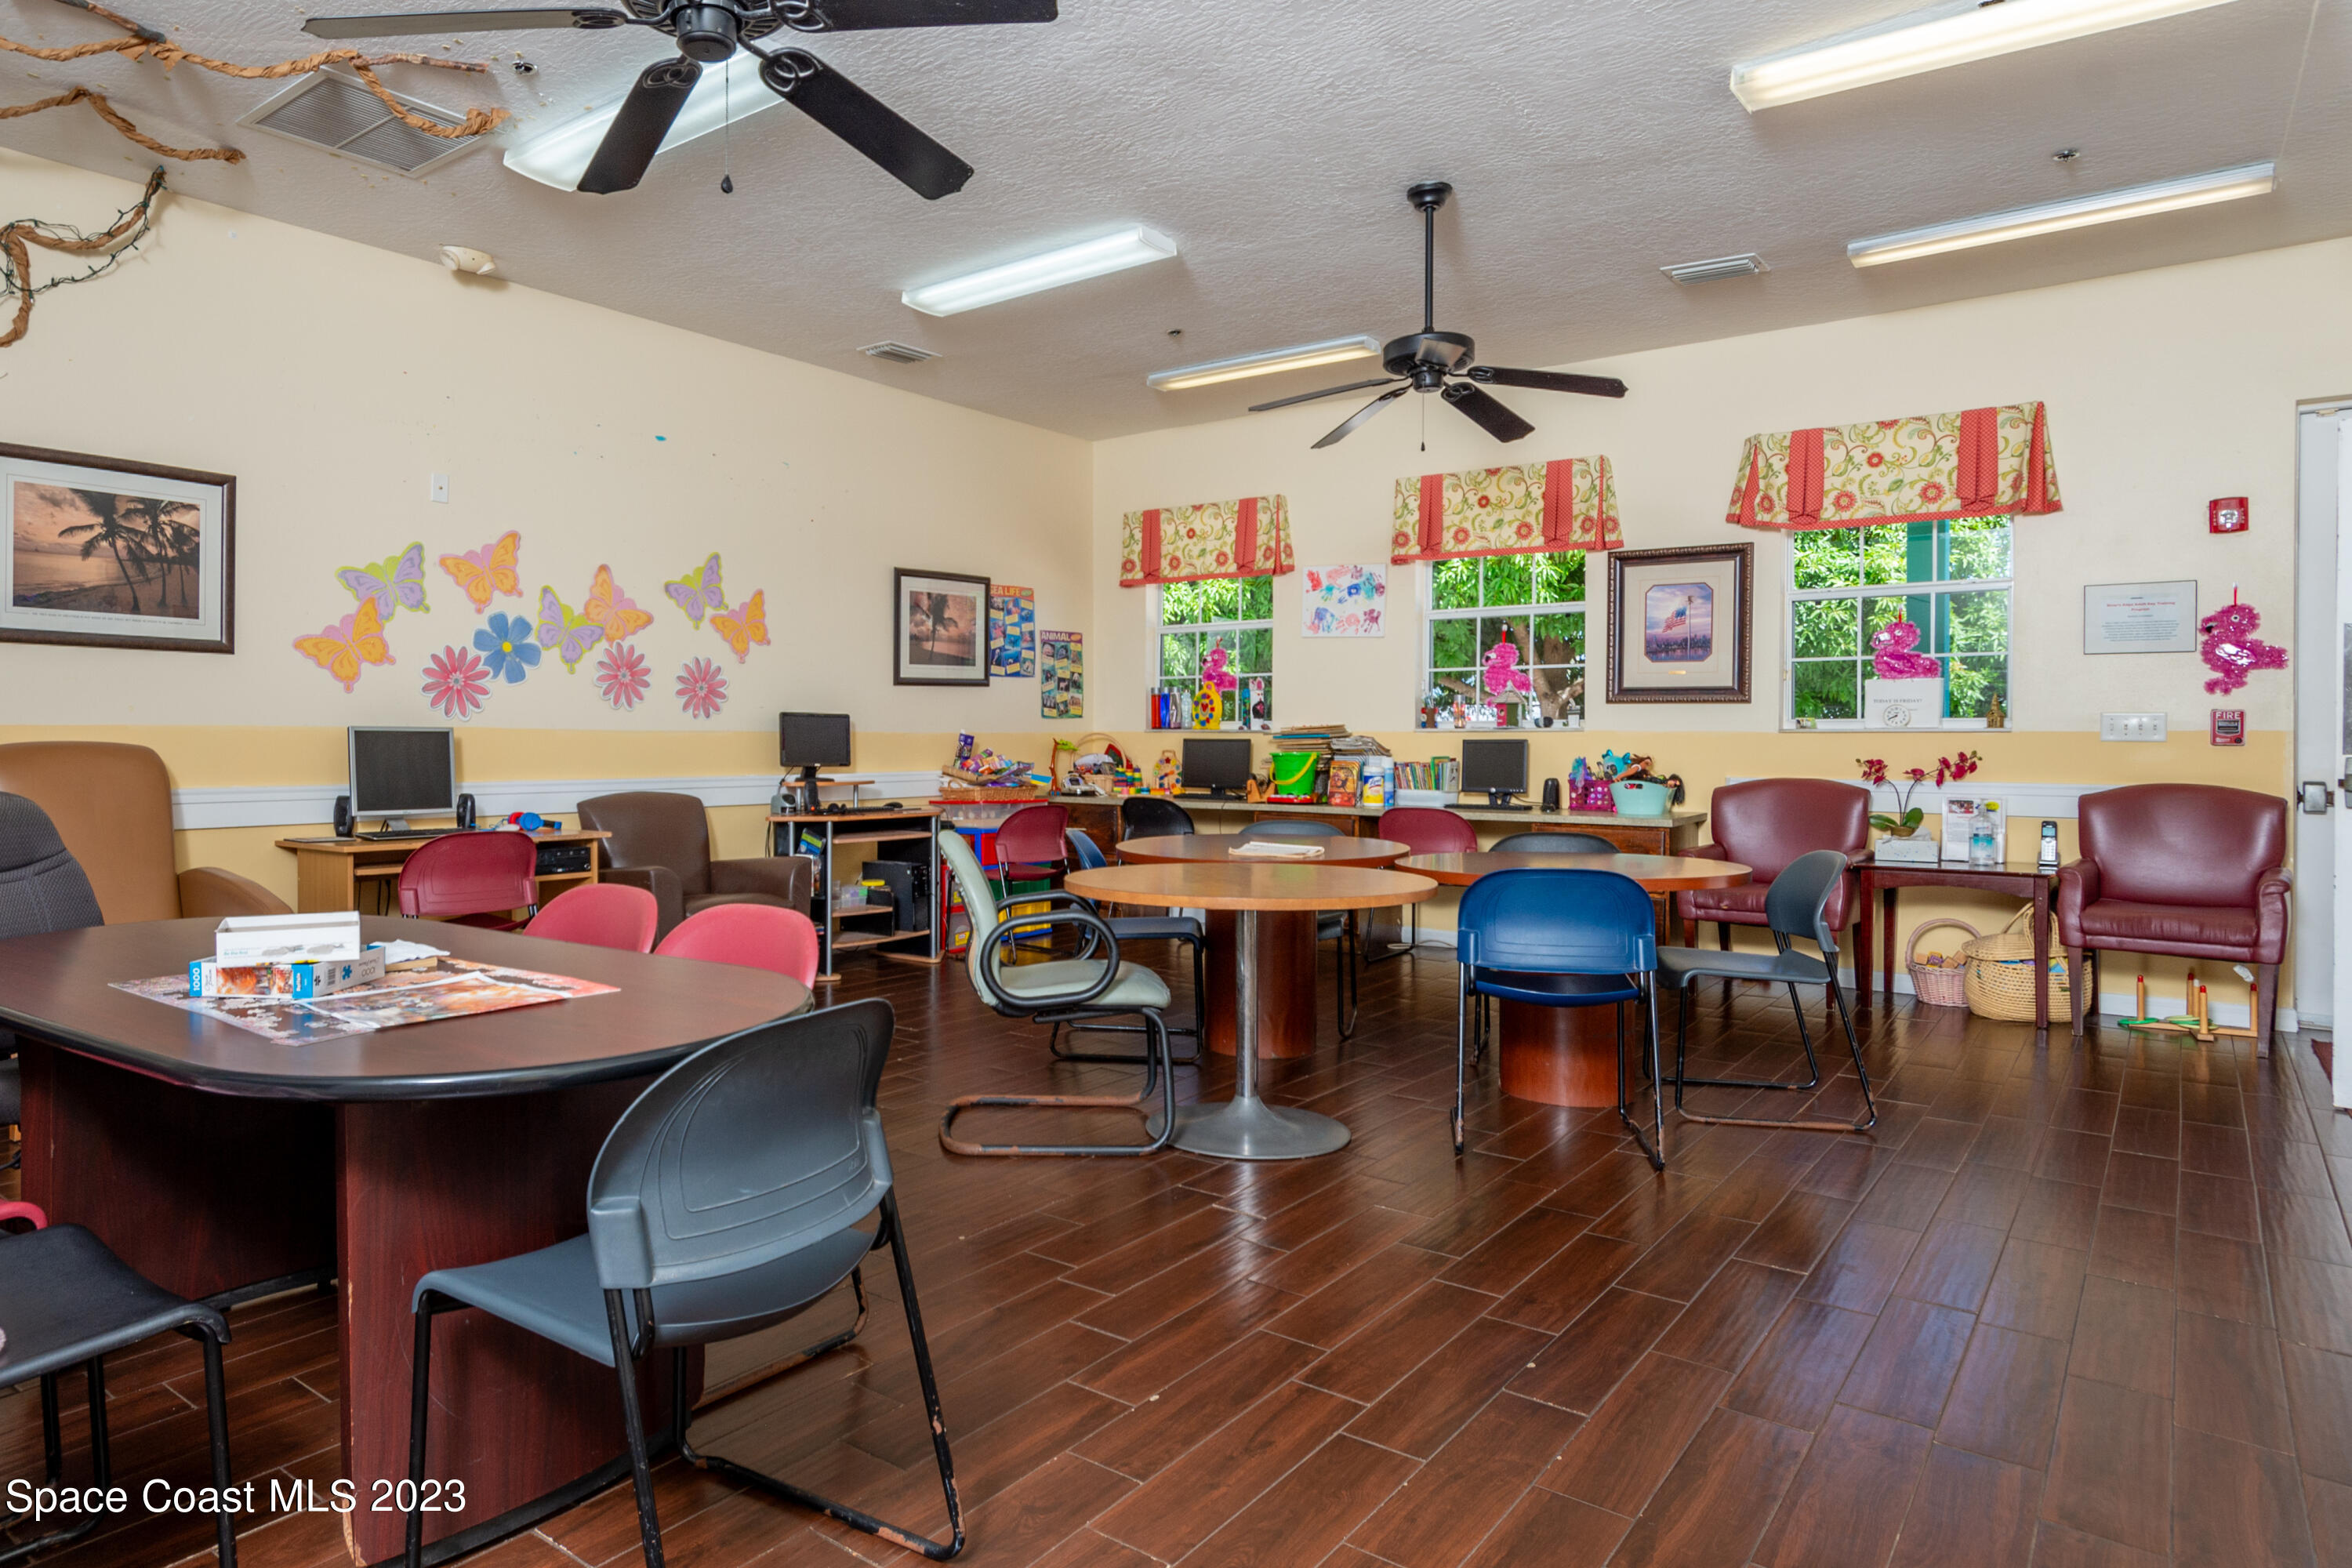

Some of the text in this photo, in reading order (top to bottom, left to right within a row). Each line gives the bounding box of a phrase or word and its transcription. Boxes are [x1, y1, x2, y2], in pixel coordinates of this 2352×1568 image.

[1004, 586, 1020, 597] LIFE
[1041, 631, 1071, 641] ANIMAL
[2216, 711, 2241, 720] FIRE
[192, 967, 201, 992] 1000
